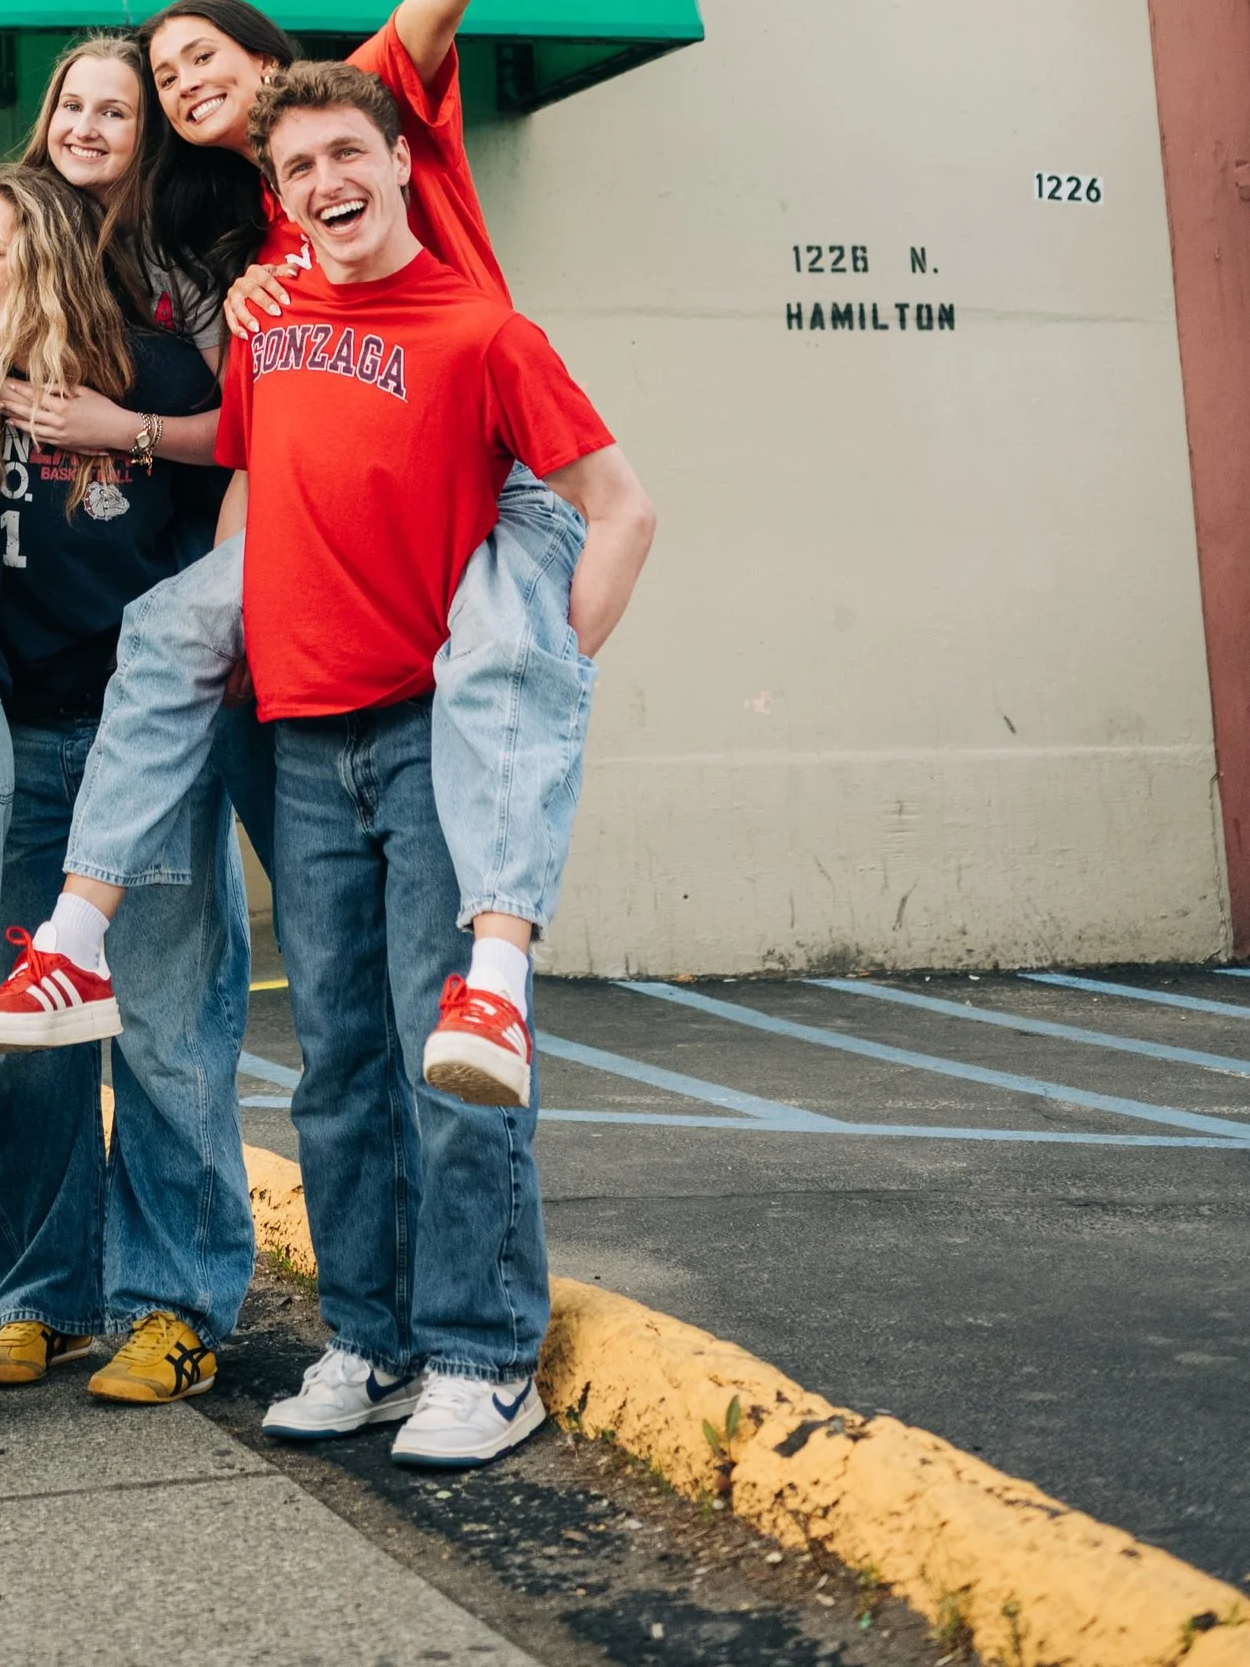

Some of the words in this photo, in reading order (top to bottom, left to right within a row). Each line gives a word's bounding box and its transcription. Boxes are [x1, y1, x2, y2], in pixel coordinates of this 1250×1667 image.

[1035, 173, 1102, 203] 1226
[792, 244, 869, 274] 1226
[910, 246, 939, 274] N.
[785, 301, 956, 332] HAMILTON
[251, 323, 408, 403] GONZAGA
